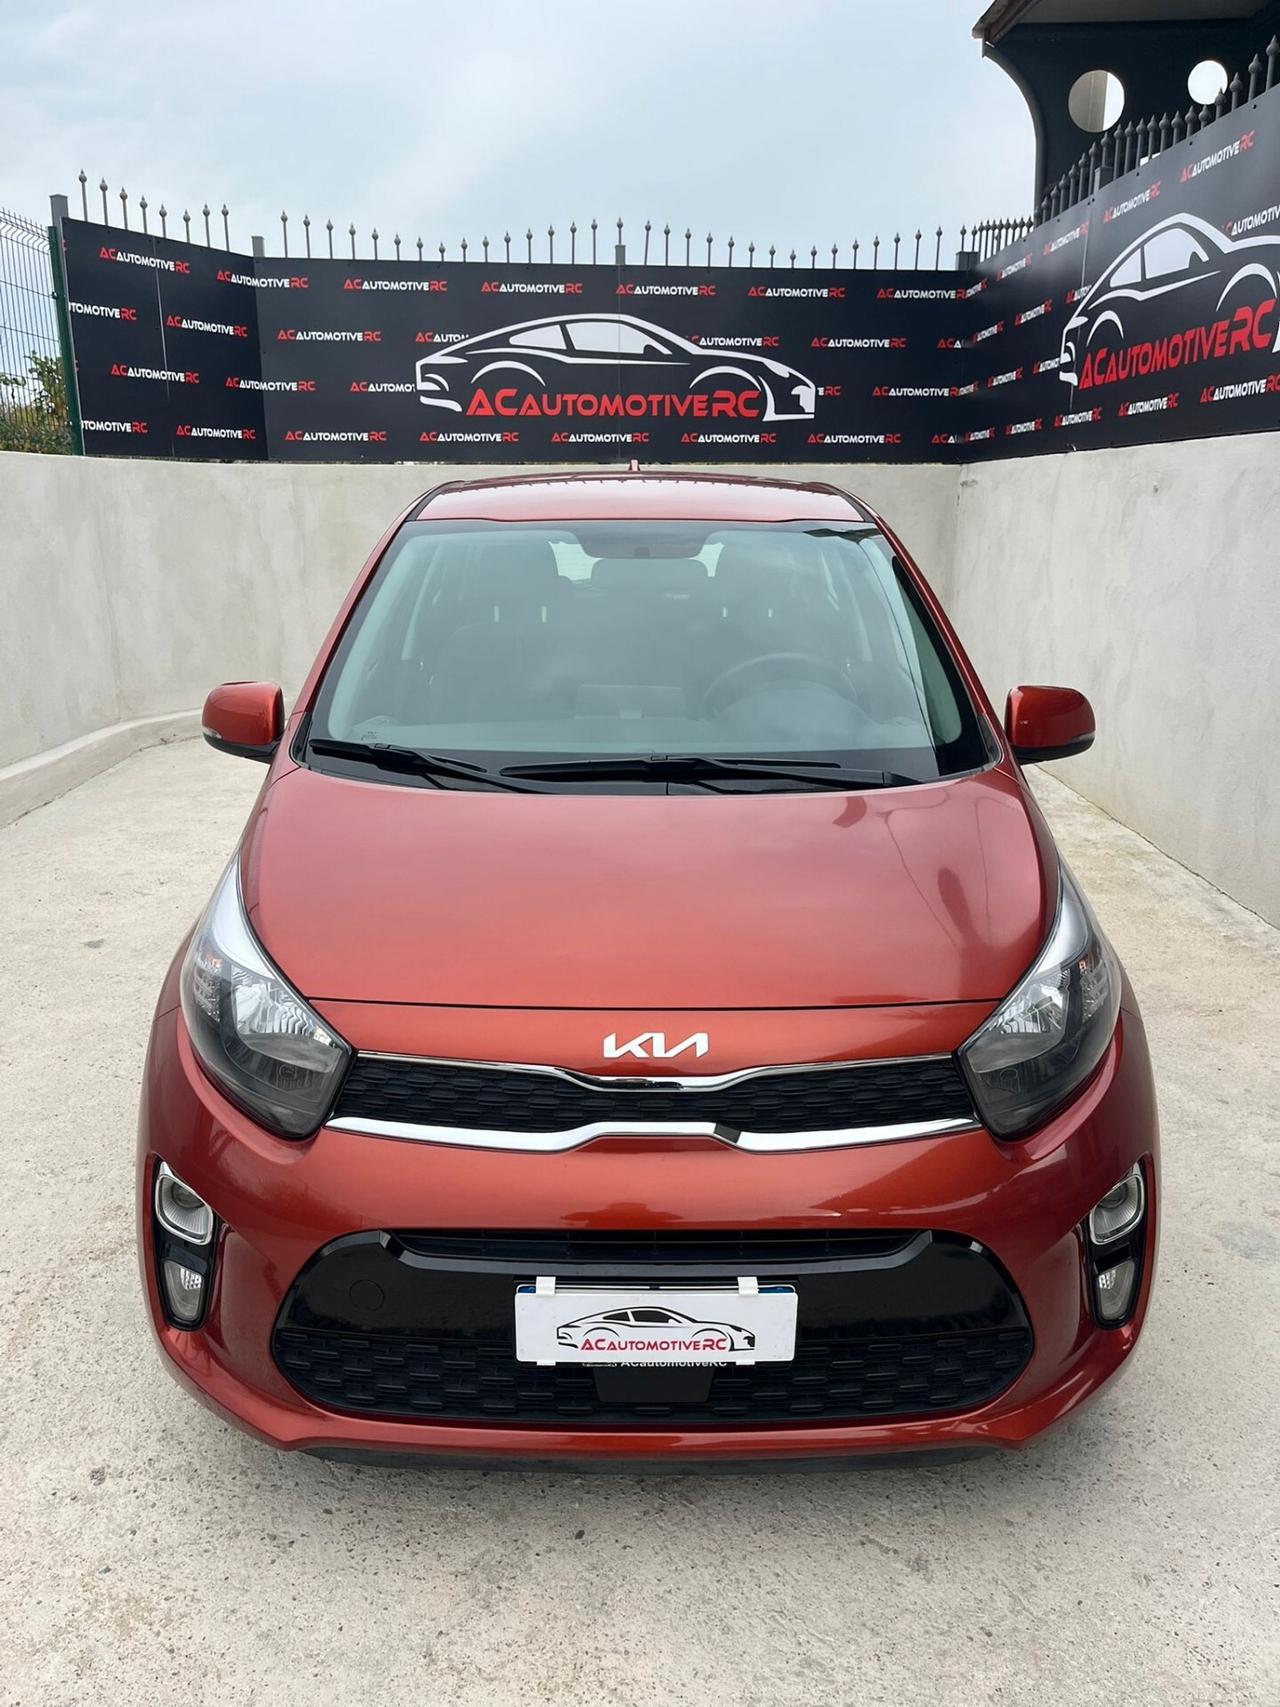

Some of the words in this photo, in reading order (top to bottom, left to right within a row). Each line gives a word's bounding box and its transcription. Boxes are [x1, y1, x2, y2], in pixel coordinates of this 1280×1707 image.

[1180, 130, 1255, 182] ACAUTOMOTIVERC
[99, 247, 190, 274] ACAUTOMOTIVERC
[216, 270, 309, 289] ACAUTOMOTIVERC
[343, 278, 448, 292] ACAUTOMOTIVERC
[481, 281, 583, 294] ACAUTOMOTIVERC
[615, 283, 716, 296] ACAUTOMOTIVERC
[748, 286, 845, 298] ACAUTOMOTIVERC
[166, 315, 248, 337] ACAUTOMOTIVERC
[277, 329, 382, 342] ACAUTOMOTIVERC
[811, 337, 907, 349] ACAUTOMOTIVERC
[1078, 297, 1277, 390] ACAUTOMOTIVERC
[111, 363, 199, 384] ACAUTOMOTIVERC
[225, 376, 316, 392] ACAUTOMOTIVERC
[817, 386, 842, 396] ERC
[465, 388, 761, 417] ACAUTOMOTIVERC
[176, 424, 256, 440] ACAUTOMOTIVERC
[284, 430, 387, 442] ACAUTOMOTIVERC
[419, 431, 519, 443] ACAUTOMOTIVERC
[551, 432, 649, 443] ACAUTOMOTIVERC
[680, 433, 776, 444] ACAUTOMOTIVERC
[808, 433, 901, 444] ACAUTOMOTIVERC
[603, 1032, 708, 1058] KIA
[580, 1338, 728, 1351] ACAUTOMOTIVERC
